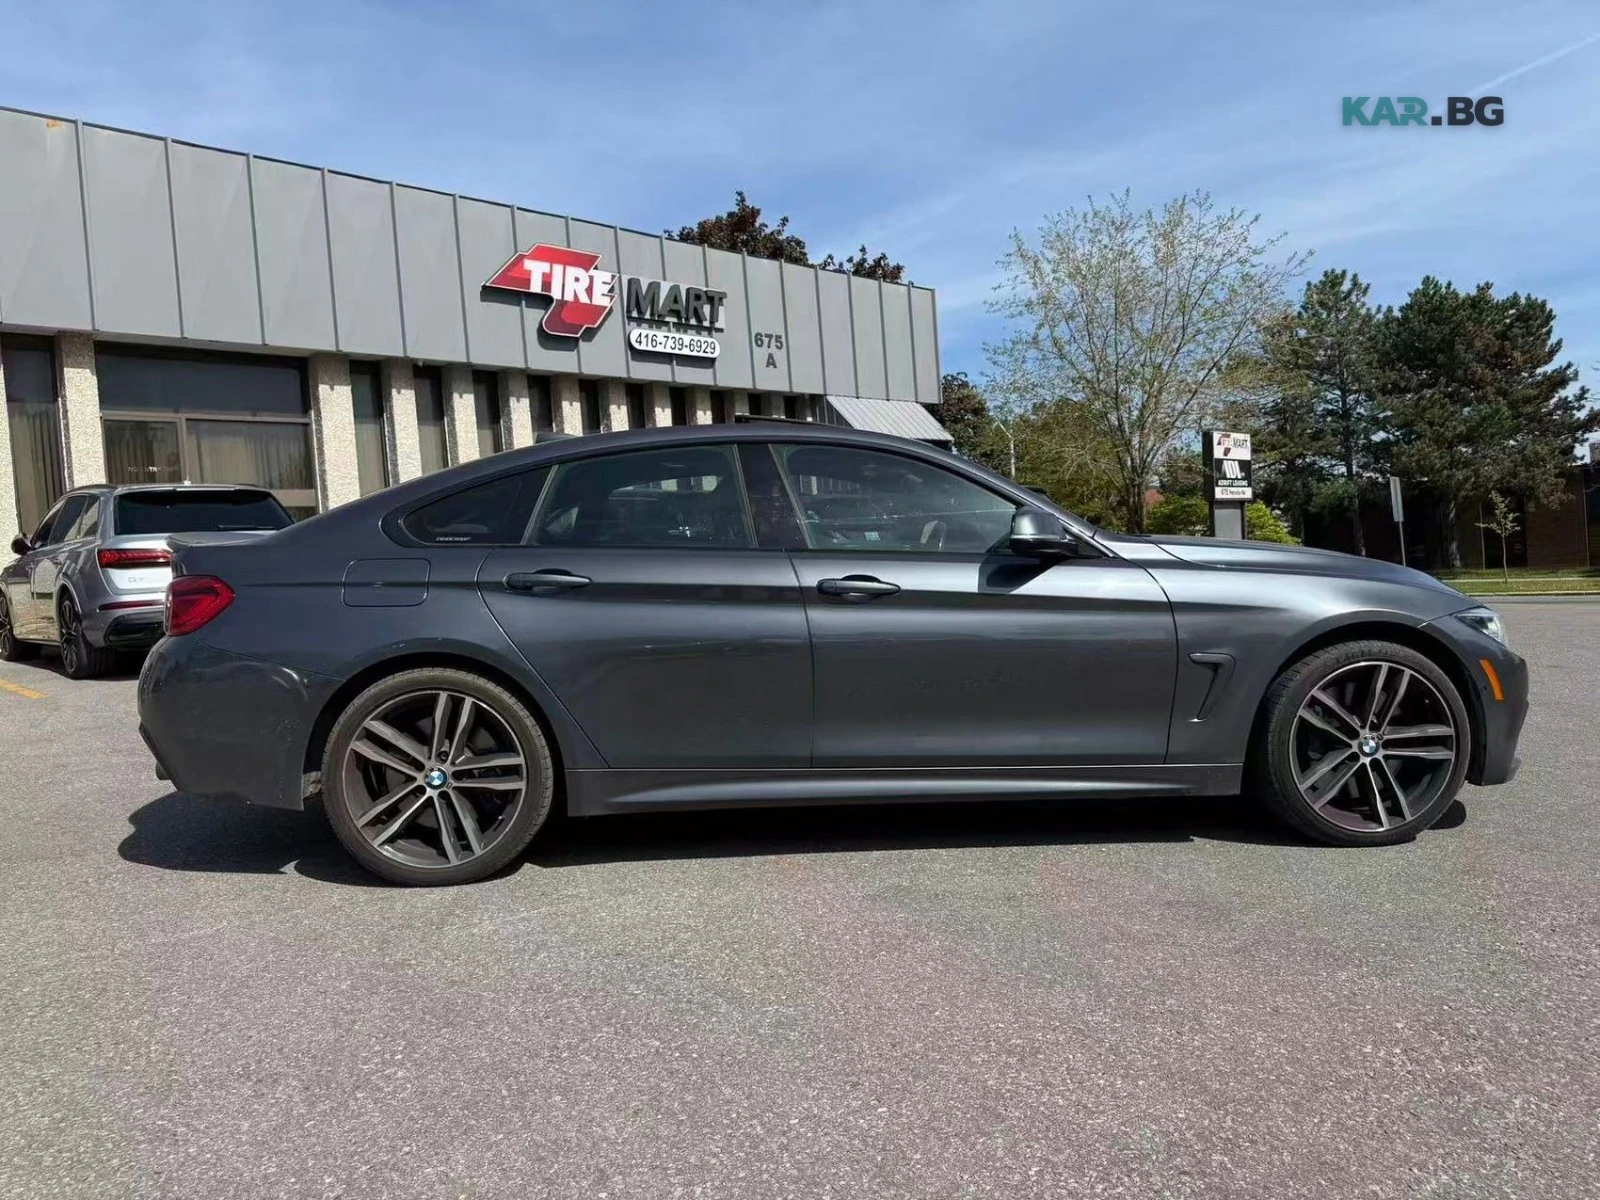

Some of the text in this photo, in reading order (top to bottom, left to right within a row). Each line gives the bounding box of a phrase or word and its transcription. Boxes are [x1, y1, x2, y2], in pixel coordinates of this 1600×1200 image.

[523, 258, 727, 325] TIRE MART
[635, 332, 717, 355] 416-739-6929
[754, 332, 784, 350] 675
[766, 353, 777, 368] A
